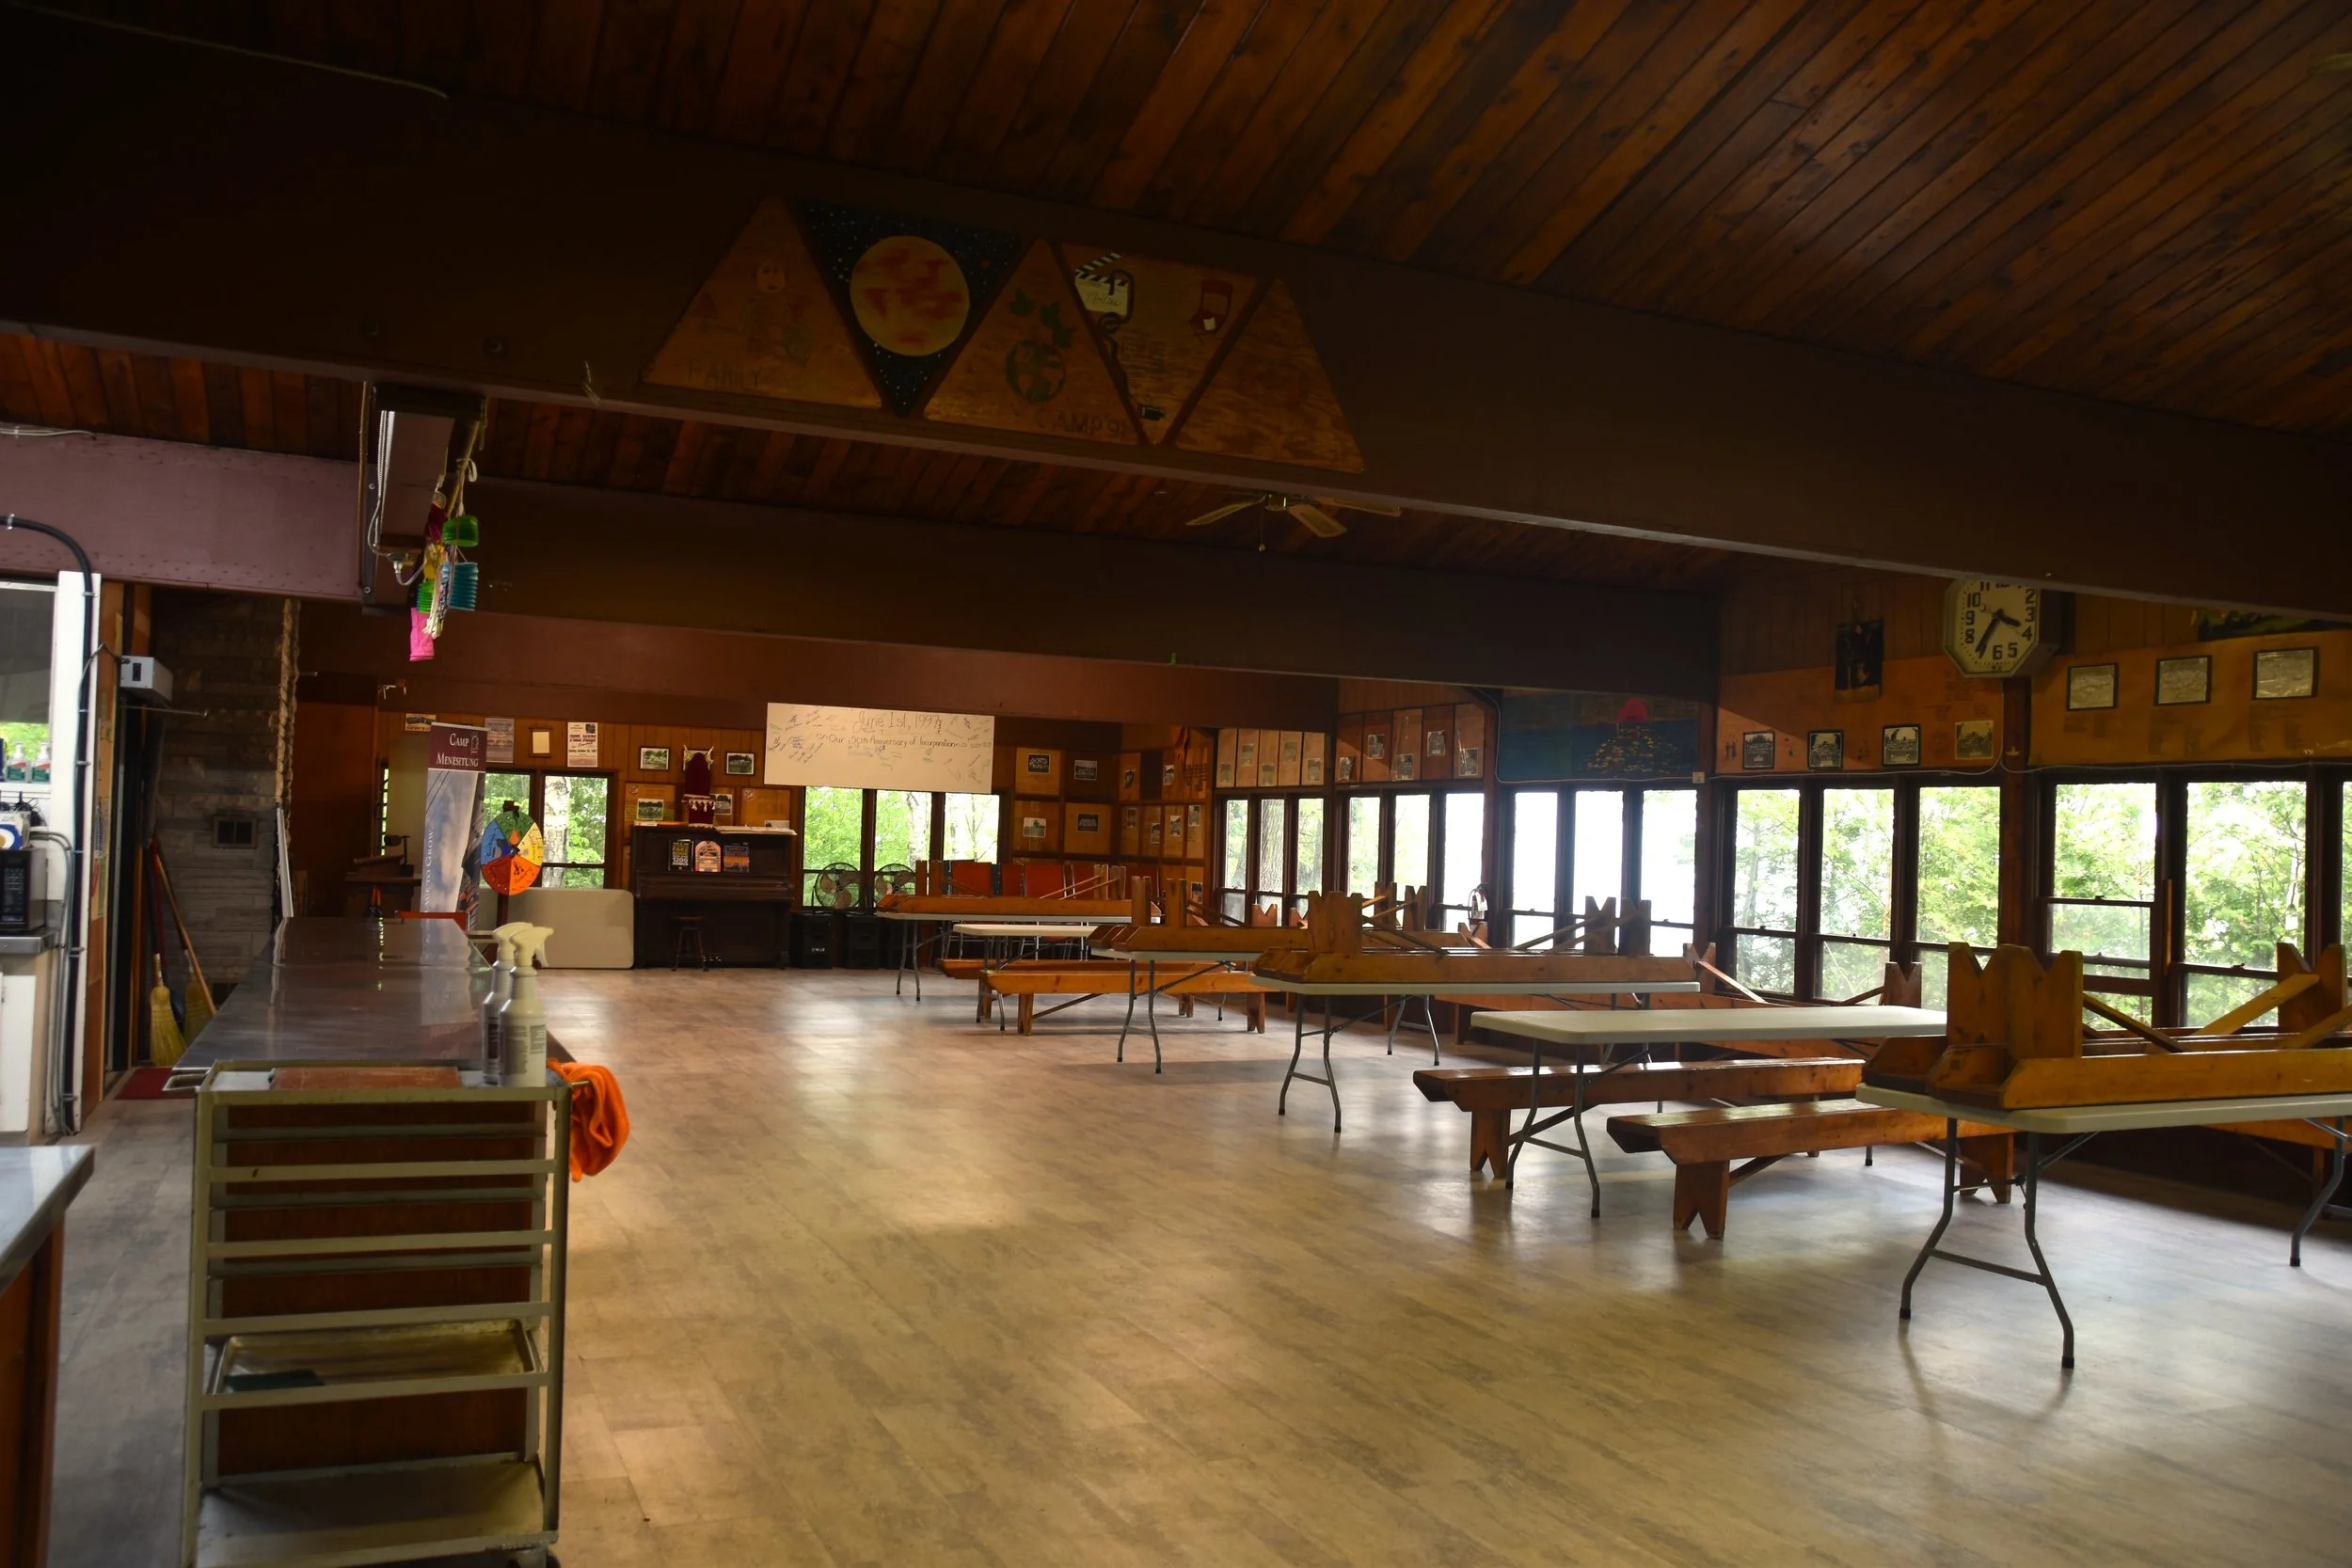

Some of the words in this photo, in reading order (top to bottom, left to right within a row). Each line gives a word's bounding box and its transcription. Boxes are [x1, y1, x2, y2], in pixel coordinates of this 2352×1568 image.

[1966, 592, 1981, 608] 10
[2025, 588, 2036, 605] 2
[1964, 610, 1976, 626] 9
[2025, 606, 2035, 623] 3
[1964, 628, 1975, 644] 8
[2021, 626, 2033, 641] 4
[1992, 644, 2003, 660] 6
[2008, 641, 2018, 658] 5
[828, 734, 845, 744] Our
[868, 735, 907, 748] Anniversary
[909, 736, 917, 746] of
